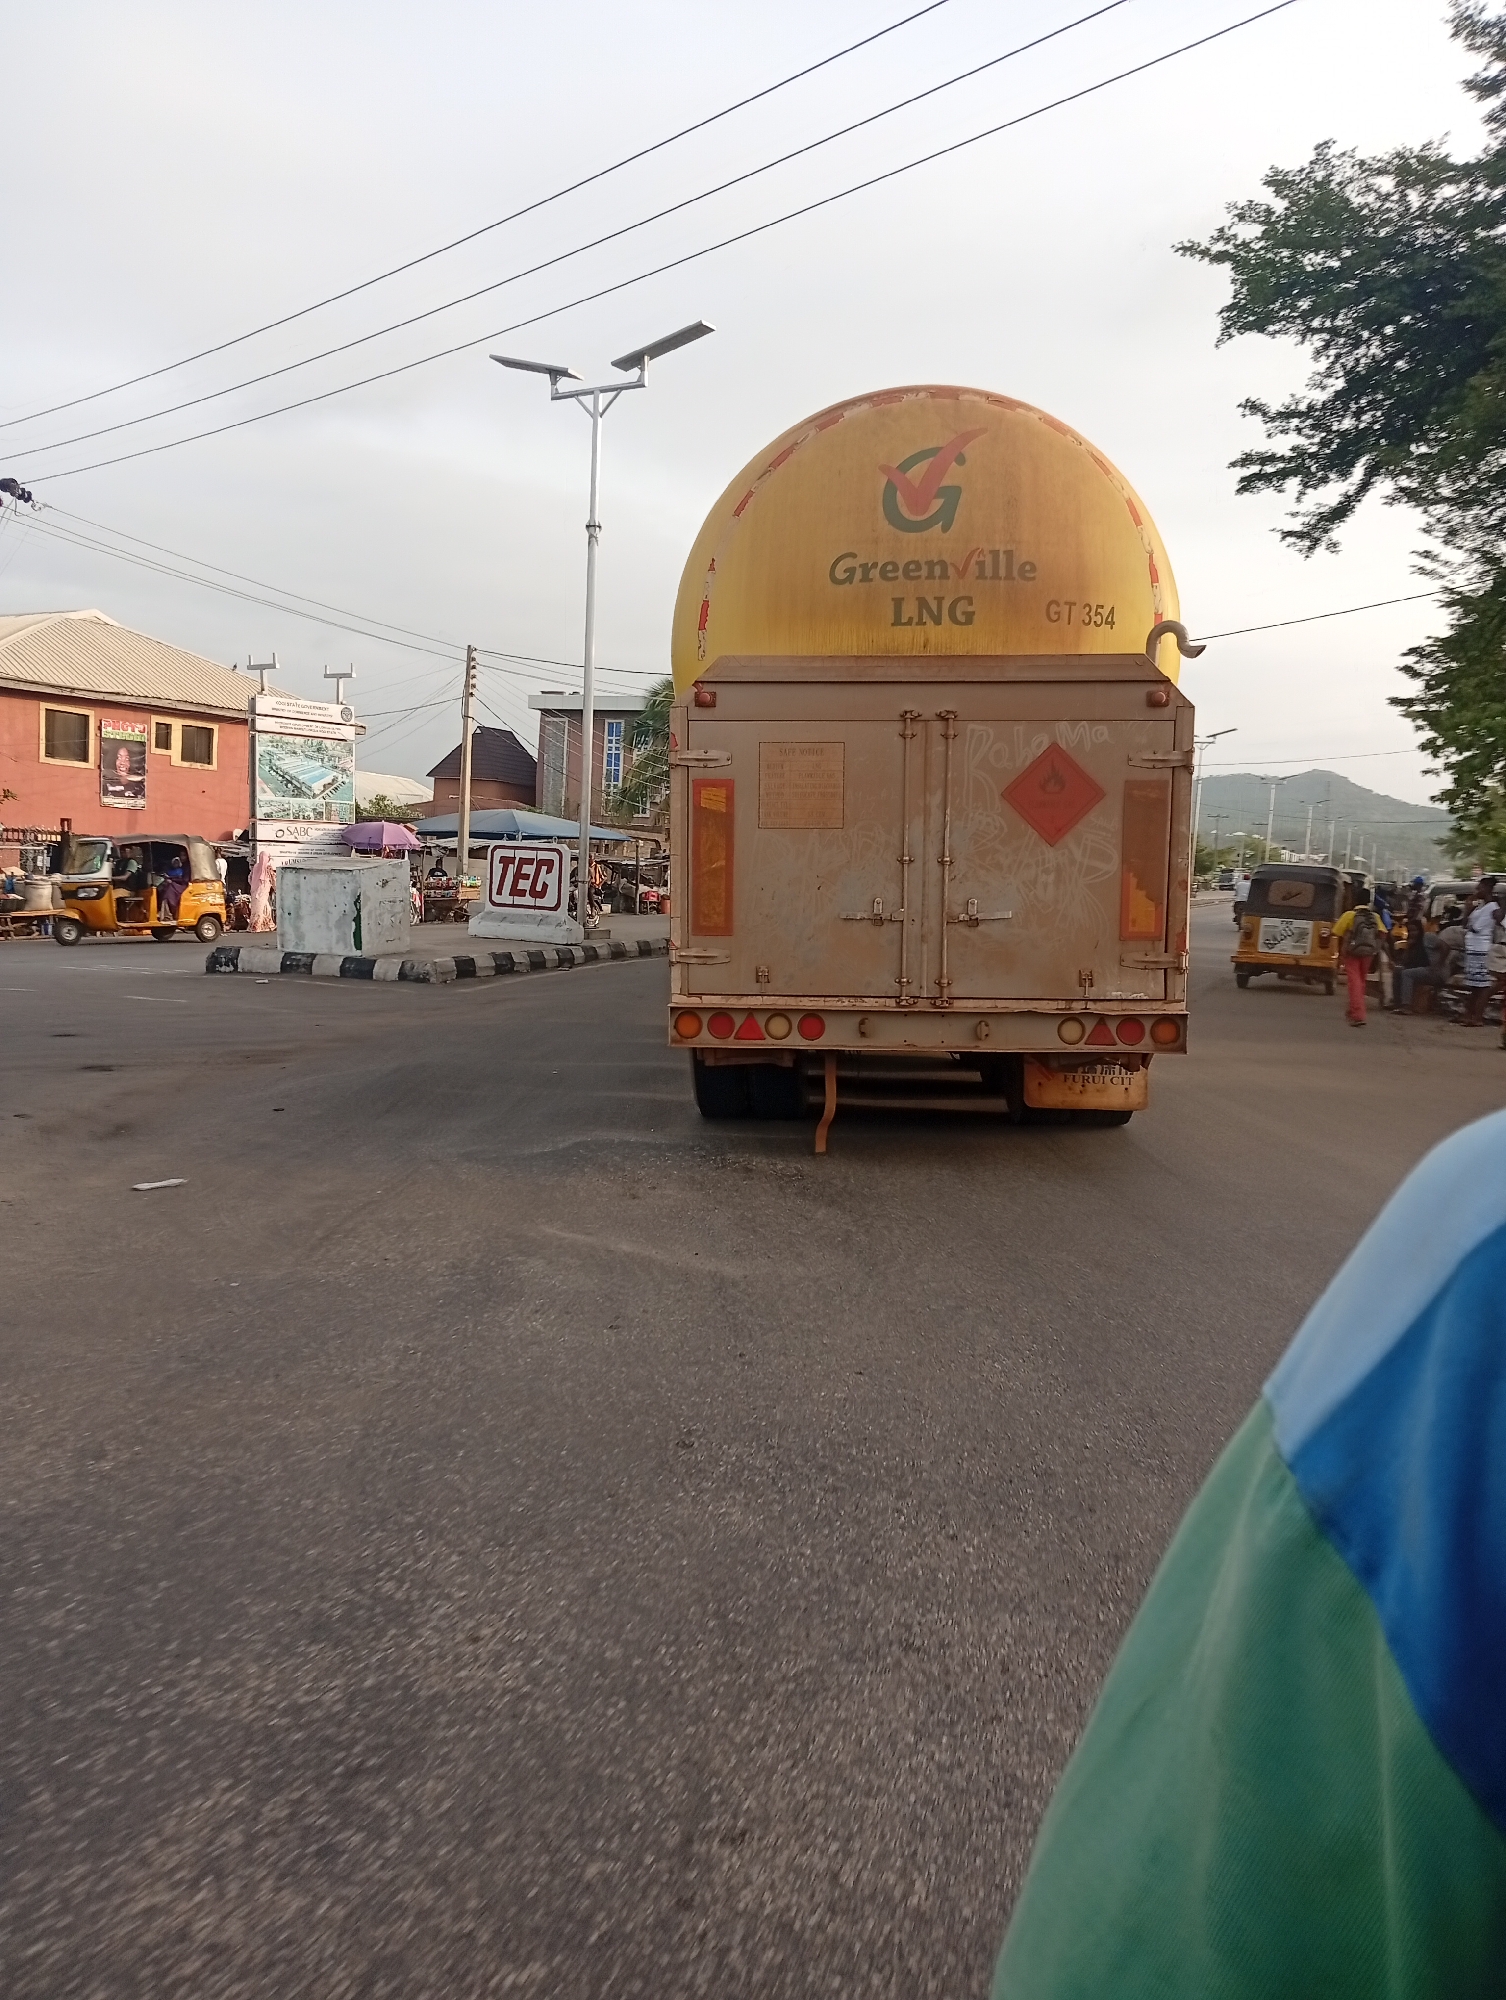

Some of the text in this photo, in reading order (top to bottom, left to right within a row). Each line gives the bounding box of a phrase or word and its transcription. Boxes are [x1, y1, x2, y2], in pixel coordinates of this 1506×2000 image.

[890, 596, 976, 627] LNG
[1045, 600, 1116, 630] GT 354
[779, 748, 825, 757] SAFE NOTICE
[286, 826, 313, 837] SABC
[496, 856, 555, 899] TEC
[1063, 1074, 1135, 1085] FURUI CIT
